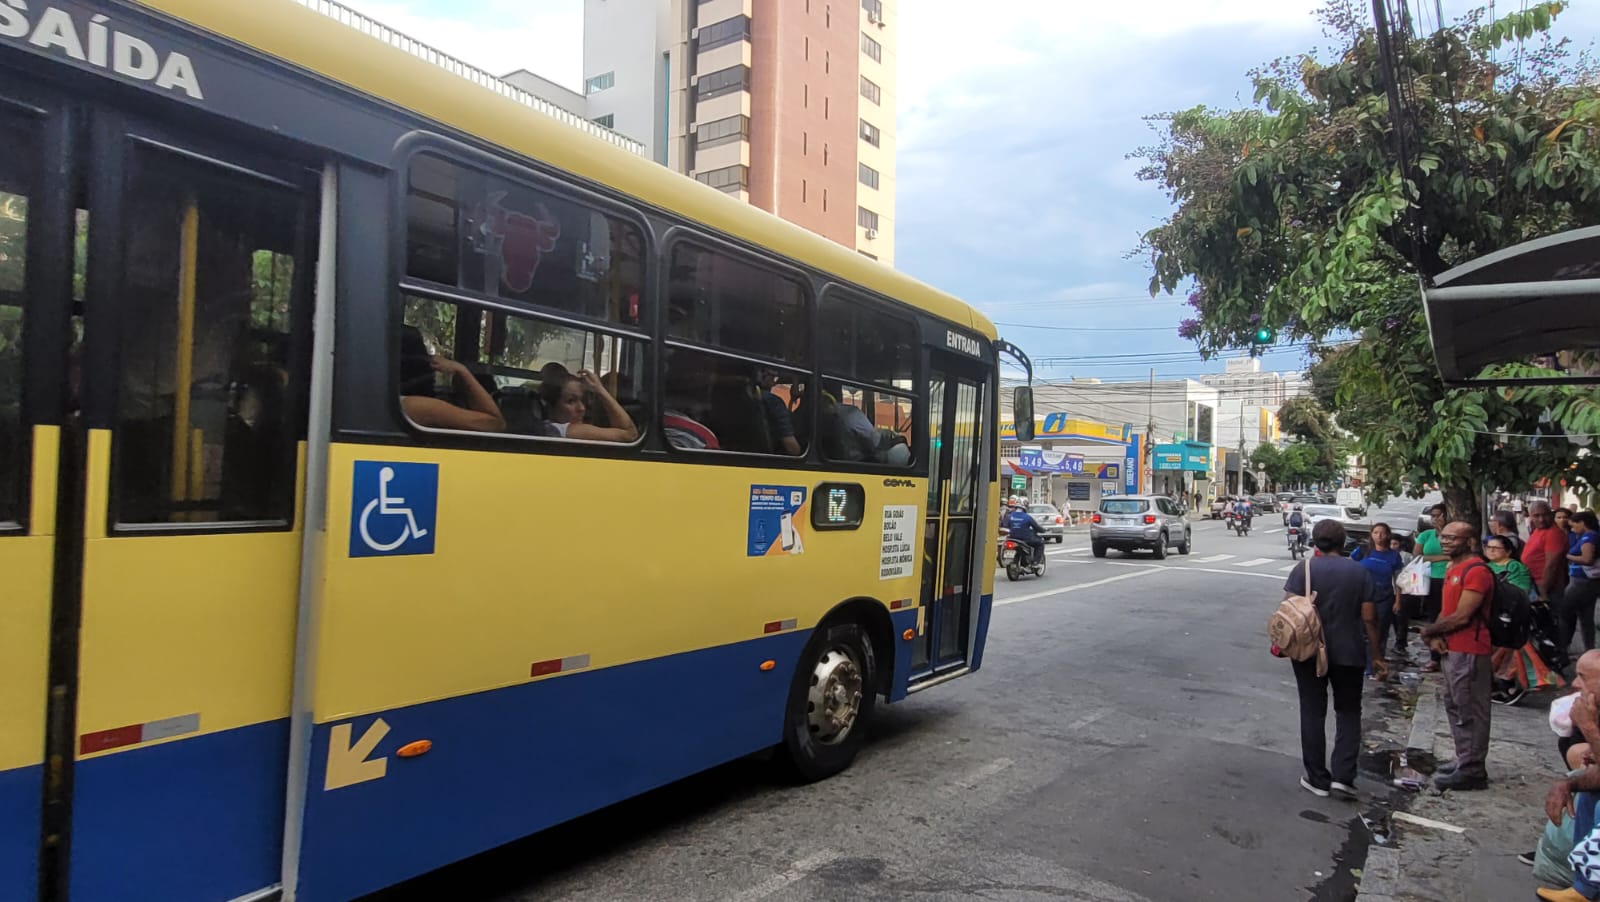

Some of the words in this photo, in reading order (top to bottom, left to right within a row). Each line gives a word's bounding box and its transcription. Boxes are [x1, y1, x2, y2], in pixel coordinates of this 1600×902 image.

[0, 0, 204, 100] SAÍDA
[946, 330, 981, 358] ENTRADA
[828, 488, 847, 522] 62
